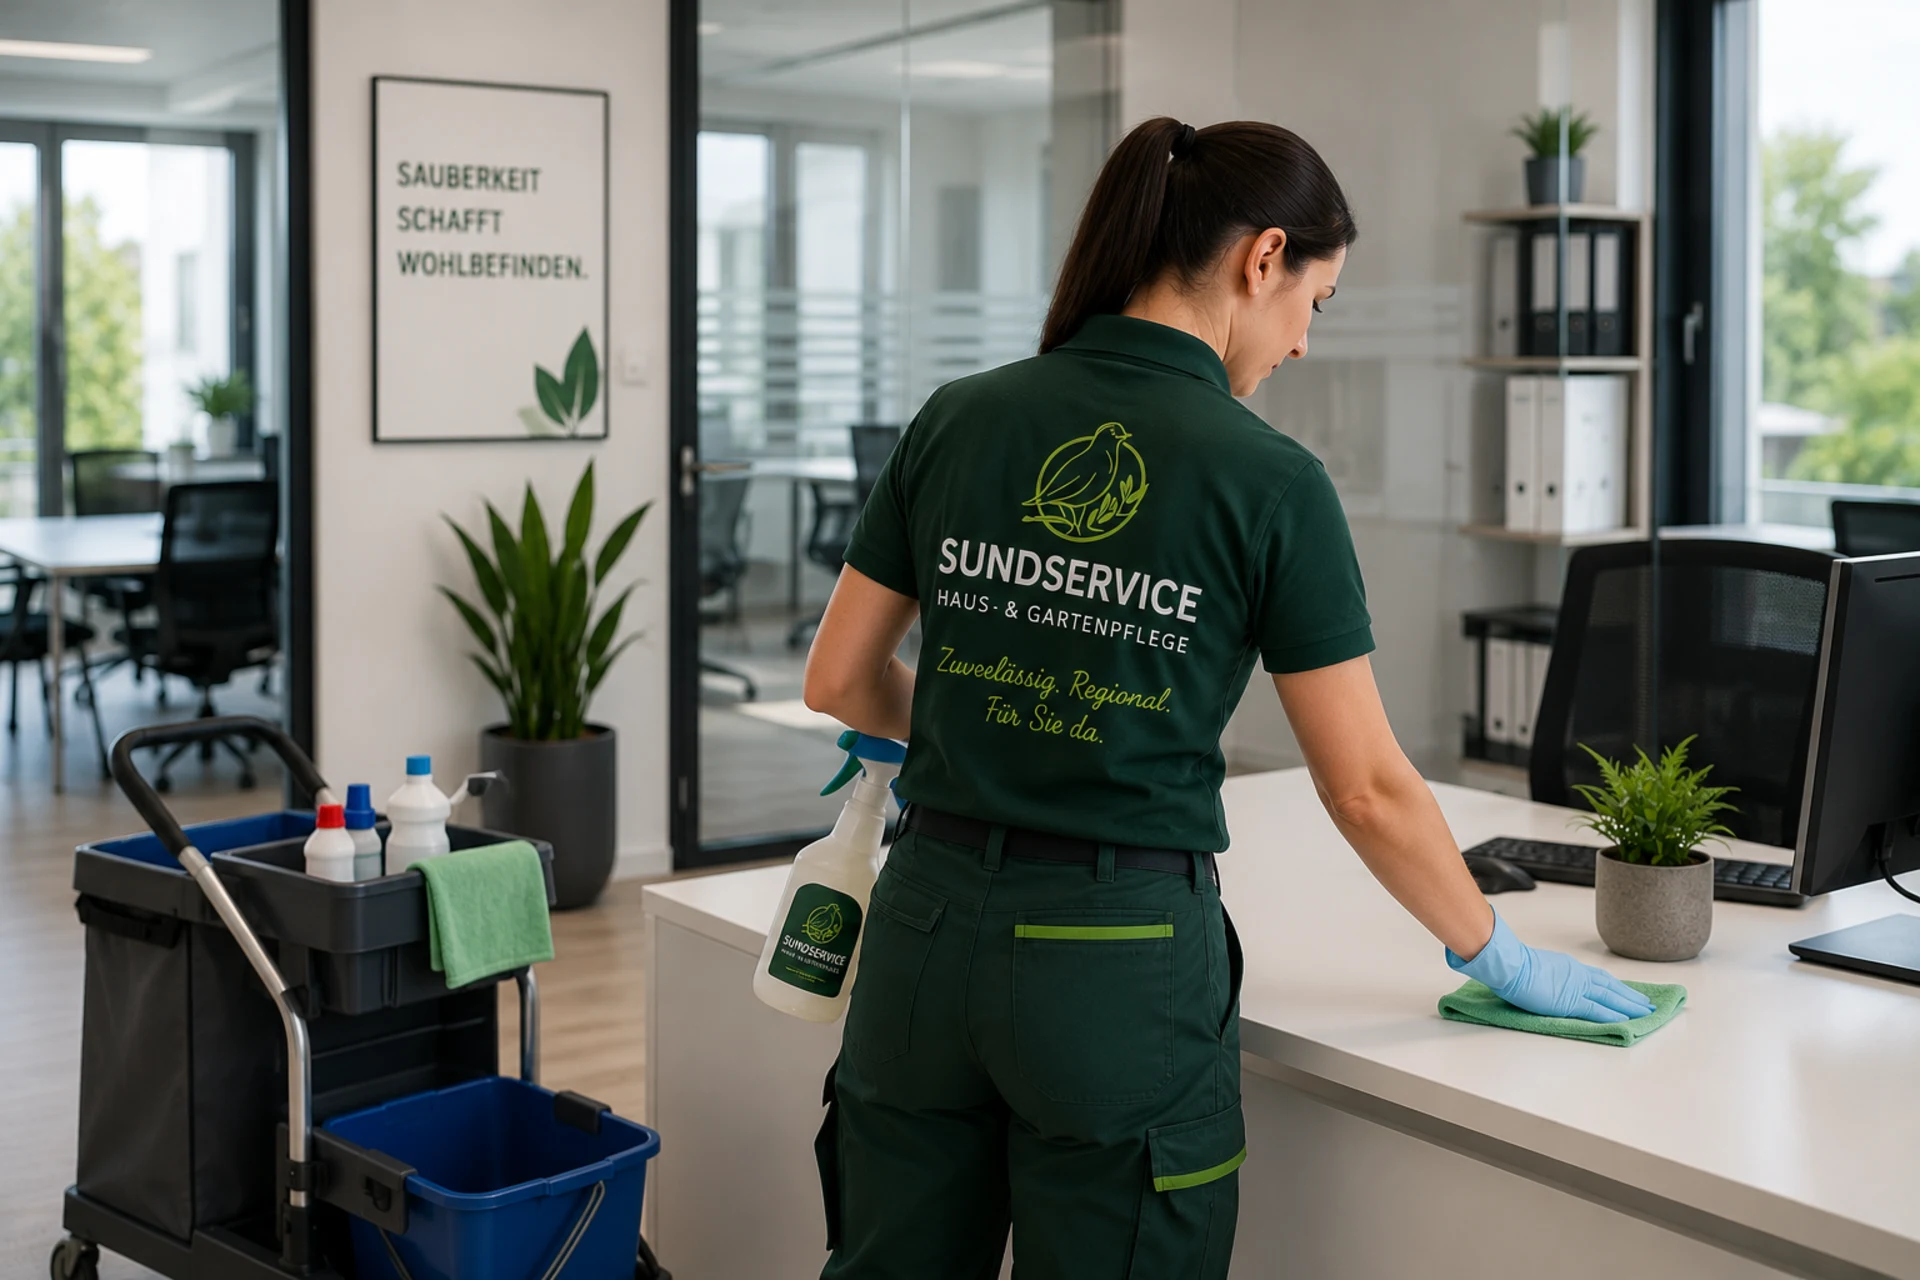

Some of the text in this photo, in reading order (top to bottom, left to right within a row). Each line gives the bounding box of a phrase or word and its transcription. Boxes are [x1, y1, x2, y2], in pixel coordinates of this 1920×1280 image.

[398, 161, 541, 192] SAUBERKEIT
[398, 206, 502, 233] SCHAFFT
[397, 251, 588, 279] WOHLBEFINDEN.
[938, 537, 1202, 623] SUNDSERVICE
[938, 589, 1190, 654] HAUS- & GARTENPFLEGE
[1069, 670, 1171, 713] Regional.
[985, 696, 1104, 743] Für Sie da.
